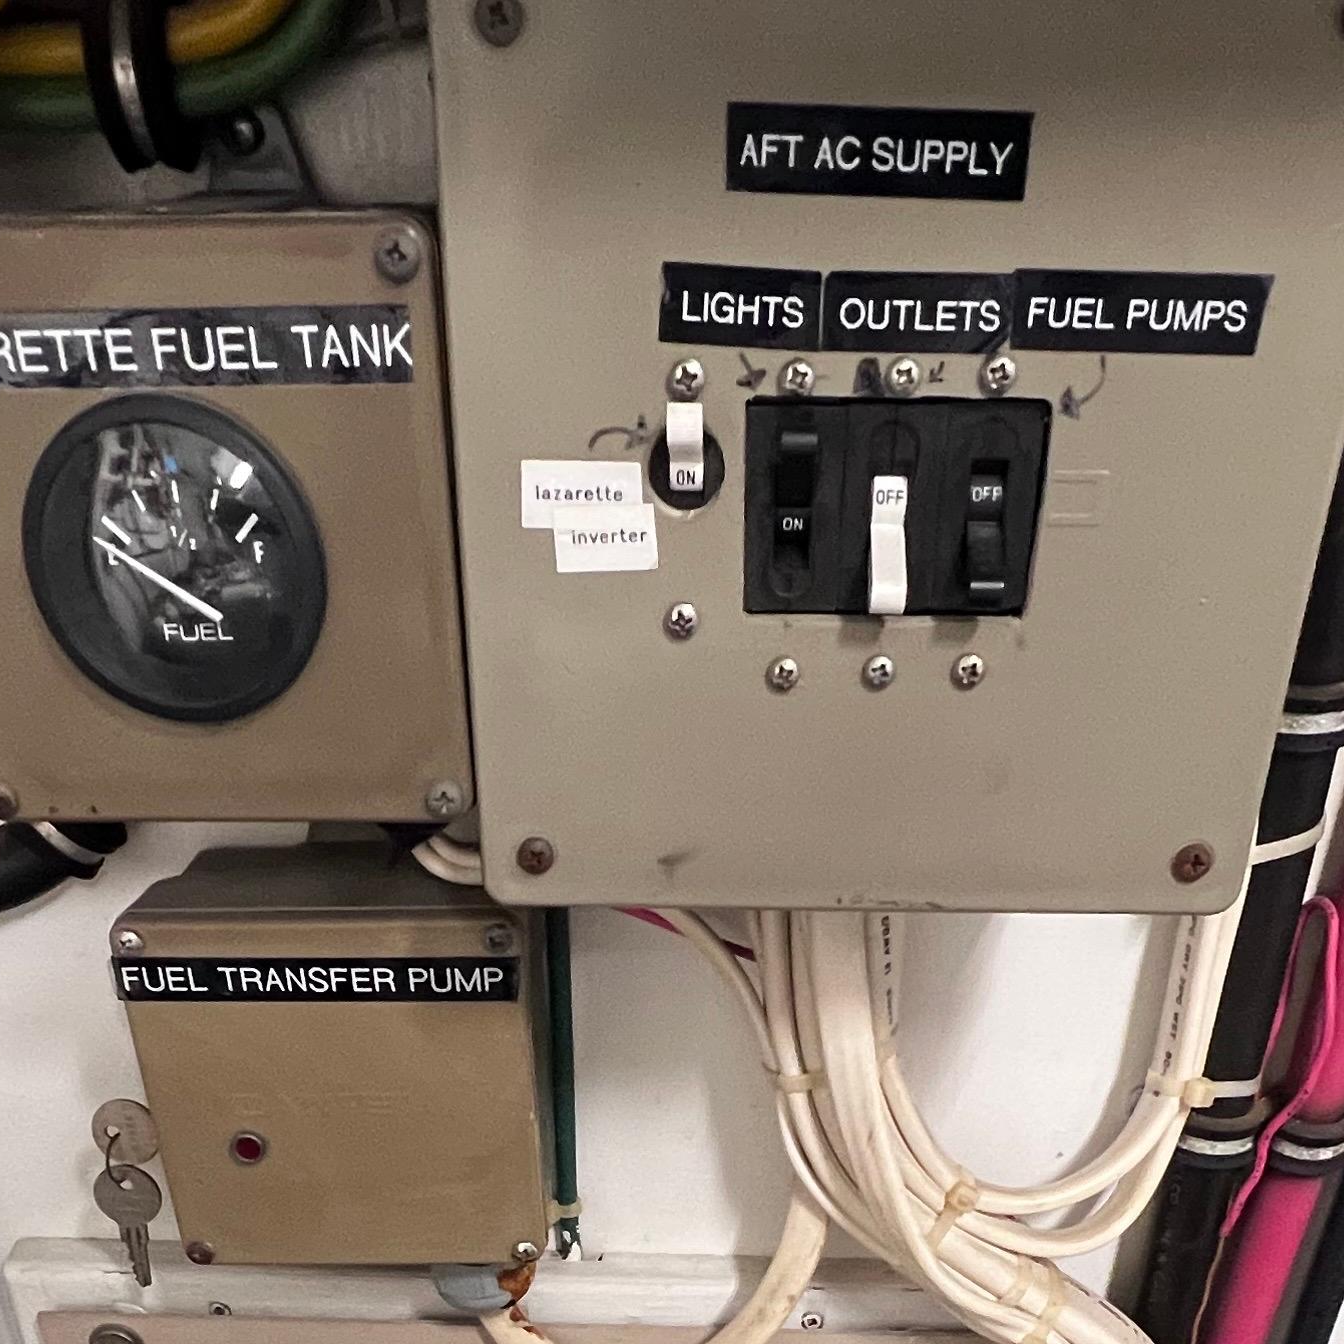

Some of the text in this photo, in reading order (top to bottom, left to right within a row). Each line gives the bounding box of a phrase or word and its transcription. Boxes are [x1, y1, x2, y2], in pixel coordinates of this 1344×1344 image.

[740, 133, 1014, 175] AFT AC SUPPLY
[680, 290, 805, 328] LIGHTS
[839, 297, 1002, 333] OUTLETS
[1026, 296, 1249, 333] FUEL PUMPS
[154, 326, 278, 372] FUEL
[291, 322, 414, 370] TANK
[676, 469, 696, 486] ON
[535, 485, 624, 502] lazarette
[875, 489, 905, 506] OFF
[971, 485, 1004, 503] OFF
[782, 516, 804, 532] ON
[571, 528, 648, 545] inverter
[252, 540, 265, 564] F
[163, 622, 234, 643] FUEL
[120, 965, 505, 993] FUEL TRANSFER PUMP
